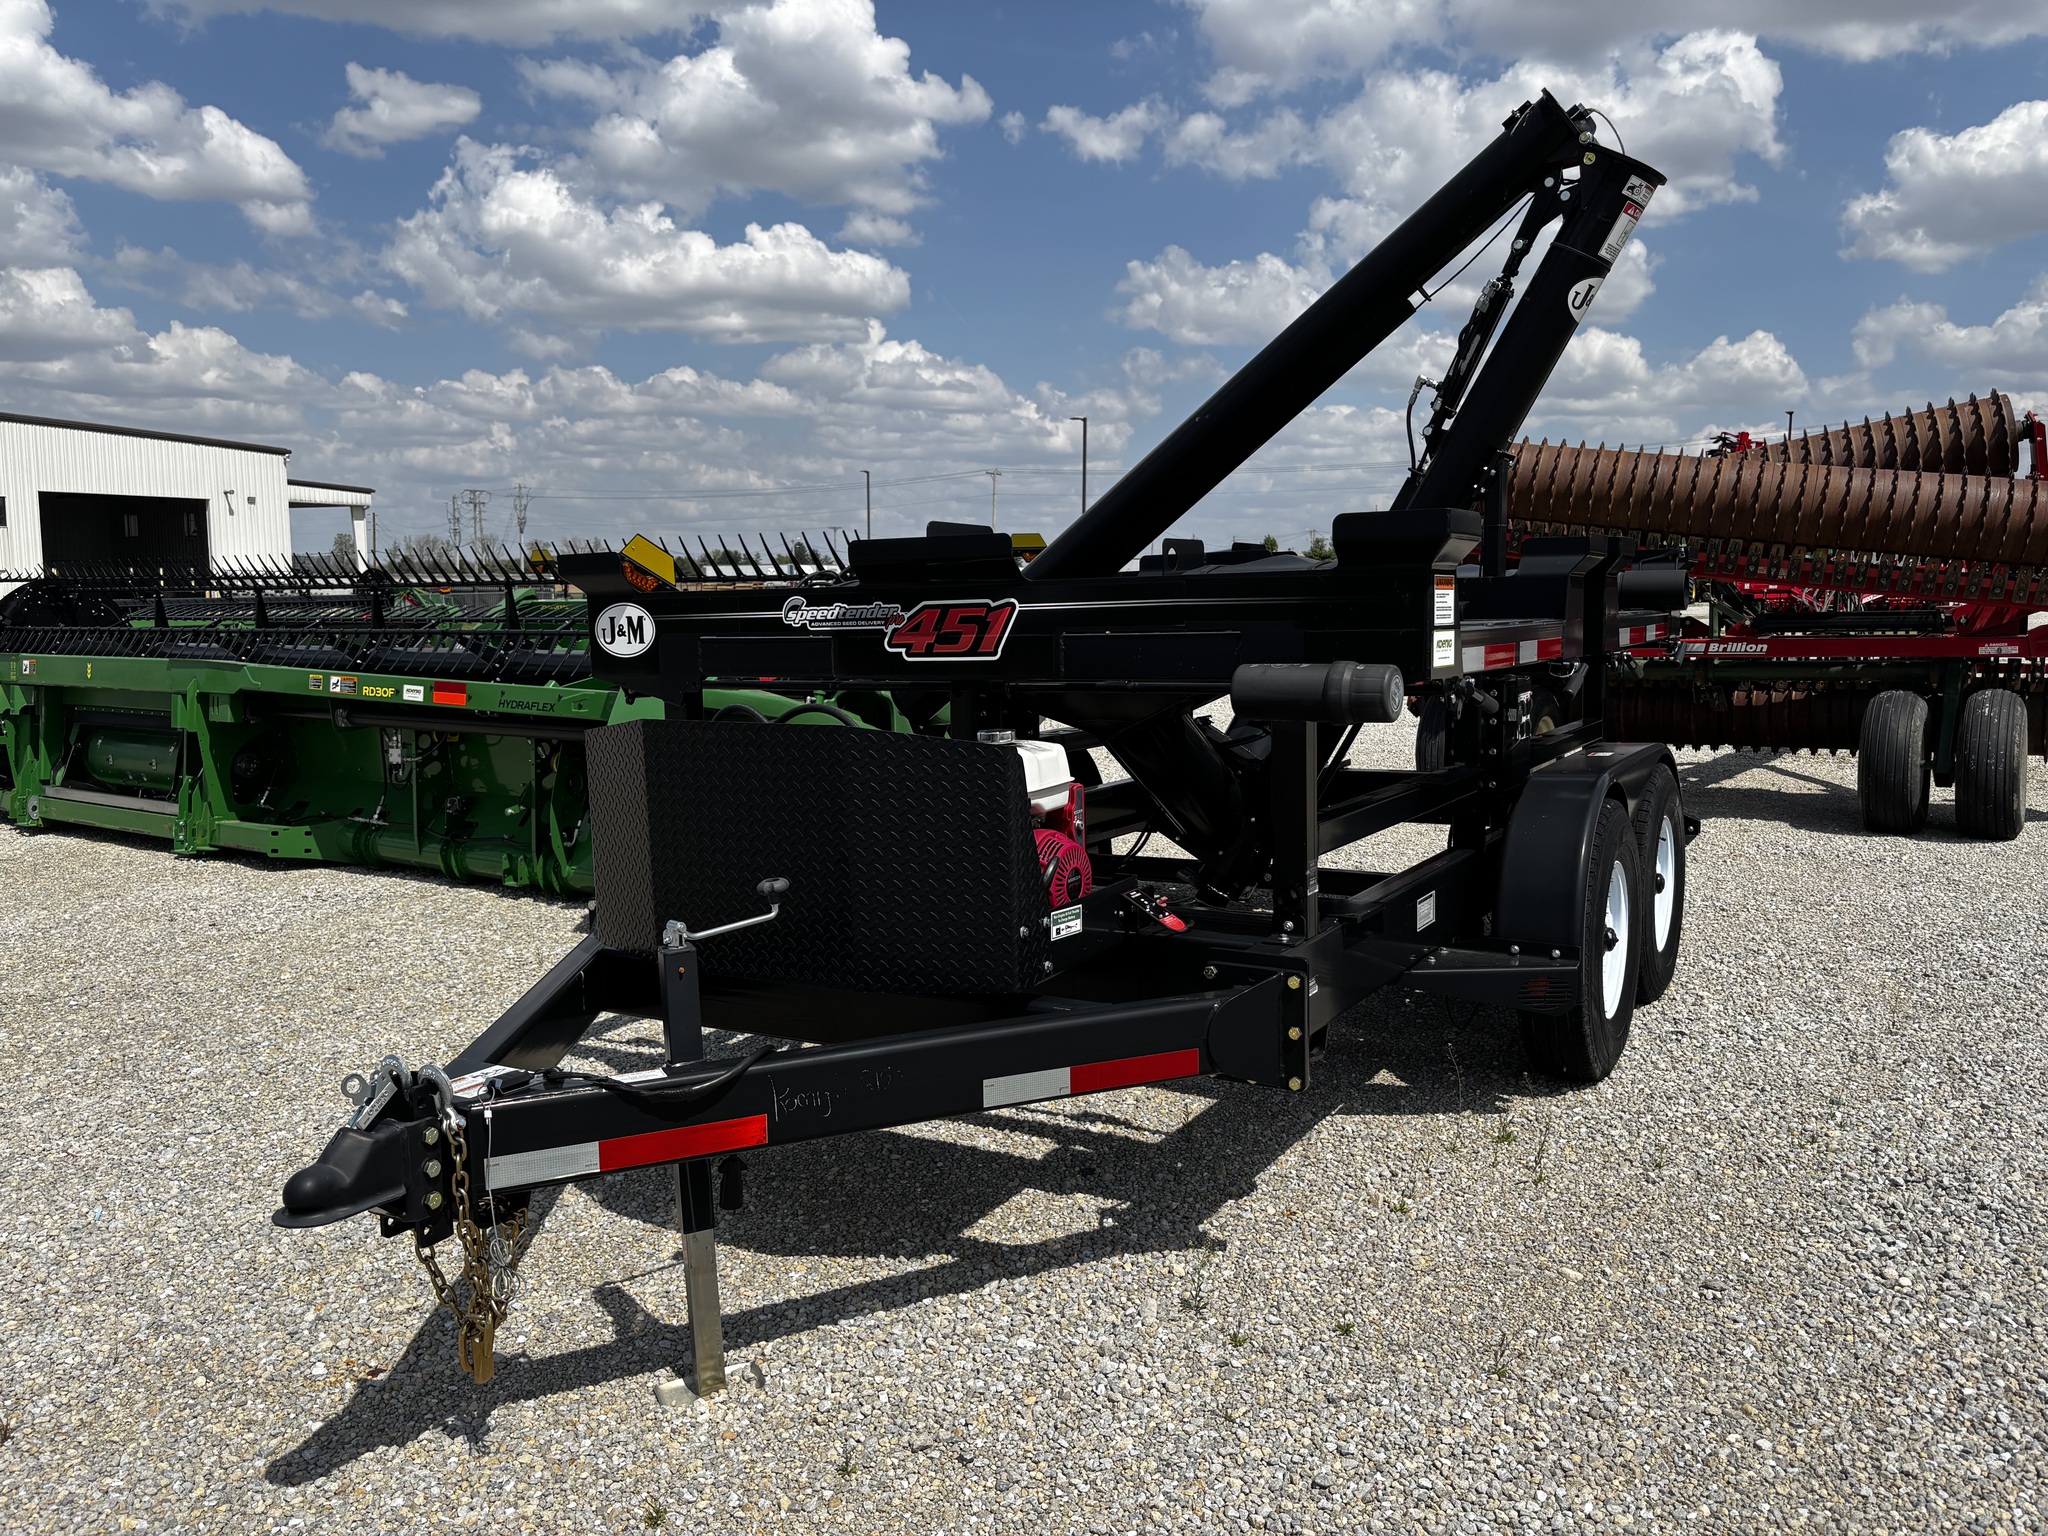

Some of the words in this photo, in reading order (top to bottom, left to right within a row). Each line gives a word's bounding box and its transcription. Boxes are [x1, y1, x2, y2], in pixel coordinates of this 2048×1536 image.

[601, 615, 646, 646] J&M
[891, 606, 1012, 653] 451
[1708, 642, 1768, 653] Brillion
[362, 686, 395, 698] RD30F
[498, 699, 556, 713] HYDRAFLEX
